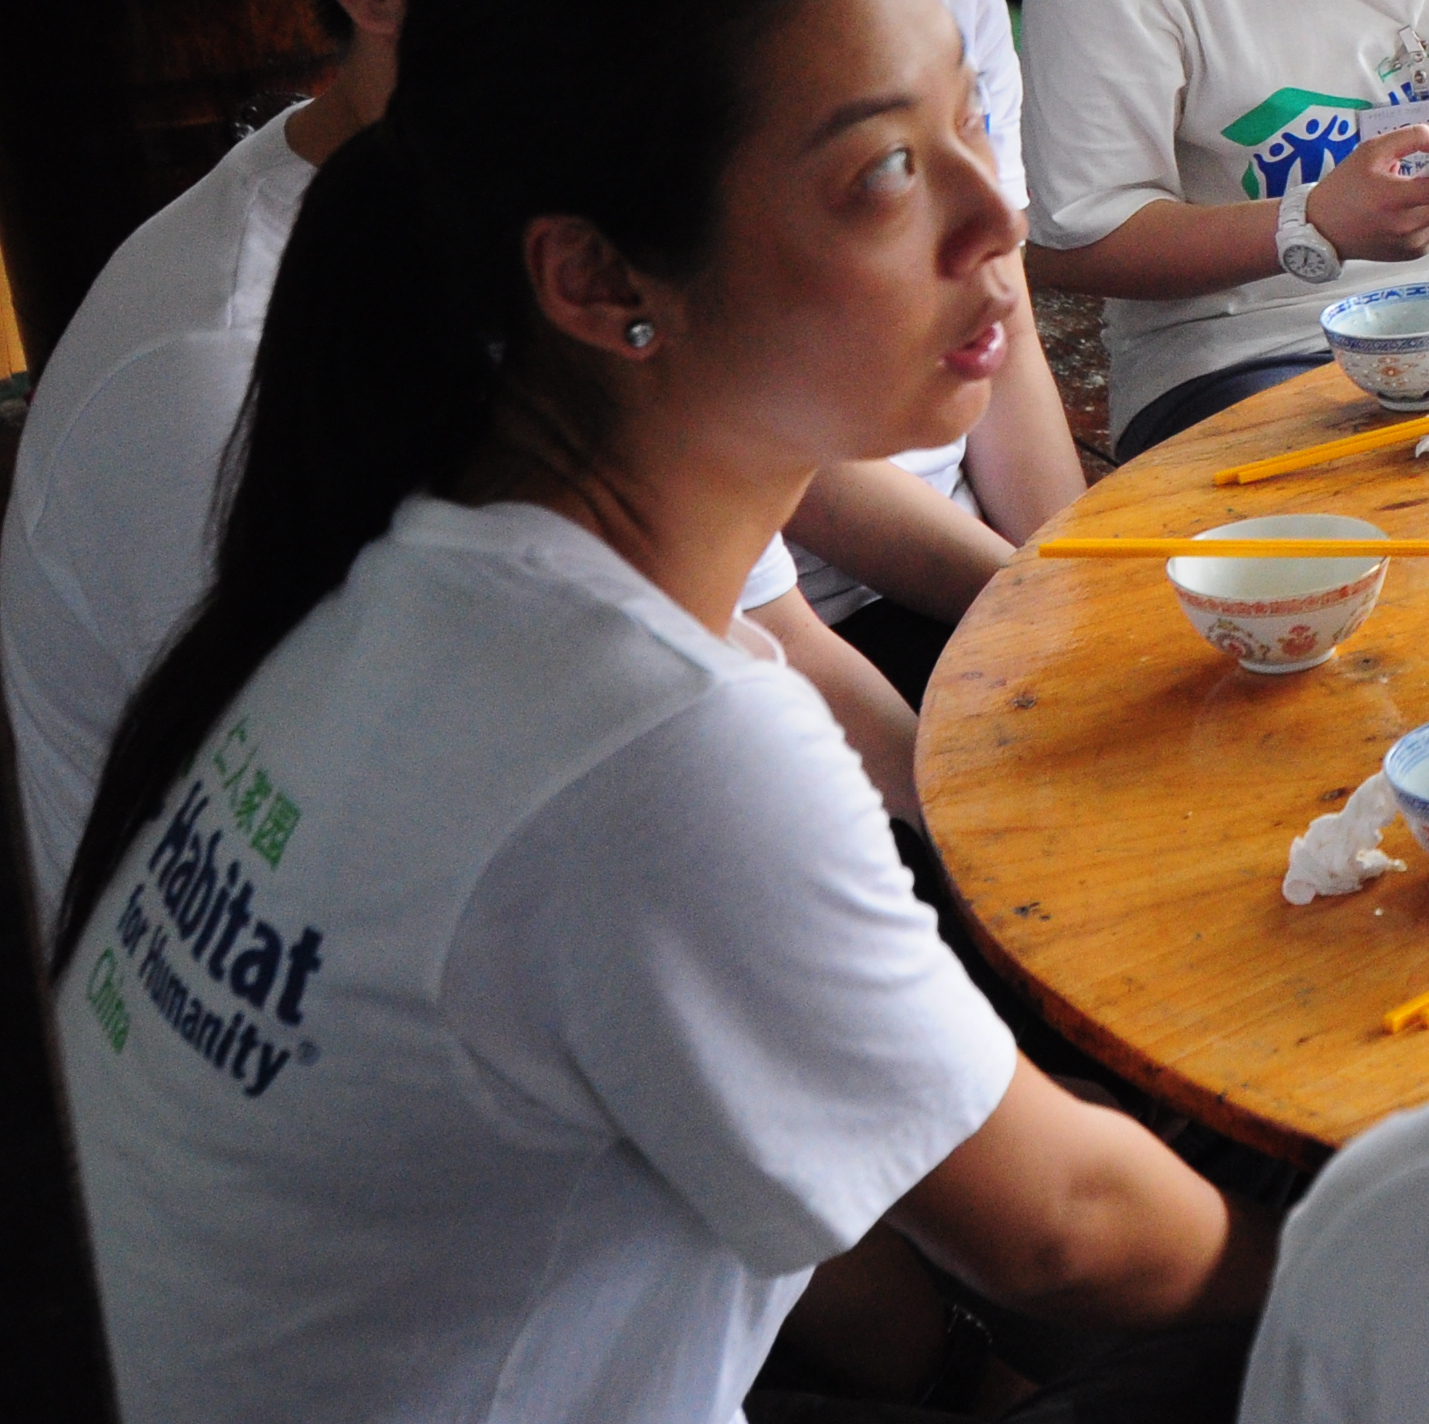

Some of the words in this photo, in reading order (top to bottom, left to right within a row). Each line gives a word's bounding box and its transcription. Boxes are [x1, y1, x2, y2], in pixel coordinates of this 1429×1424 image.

[212, 715, 302, 871] 仁人家园
[116, 883, 150, 957] for
[137, 927, 291, 1098] Humanity
[147, 778, 324, 1026] Habitat
[86, 947, 131, 1055] China
